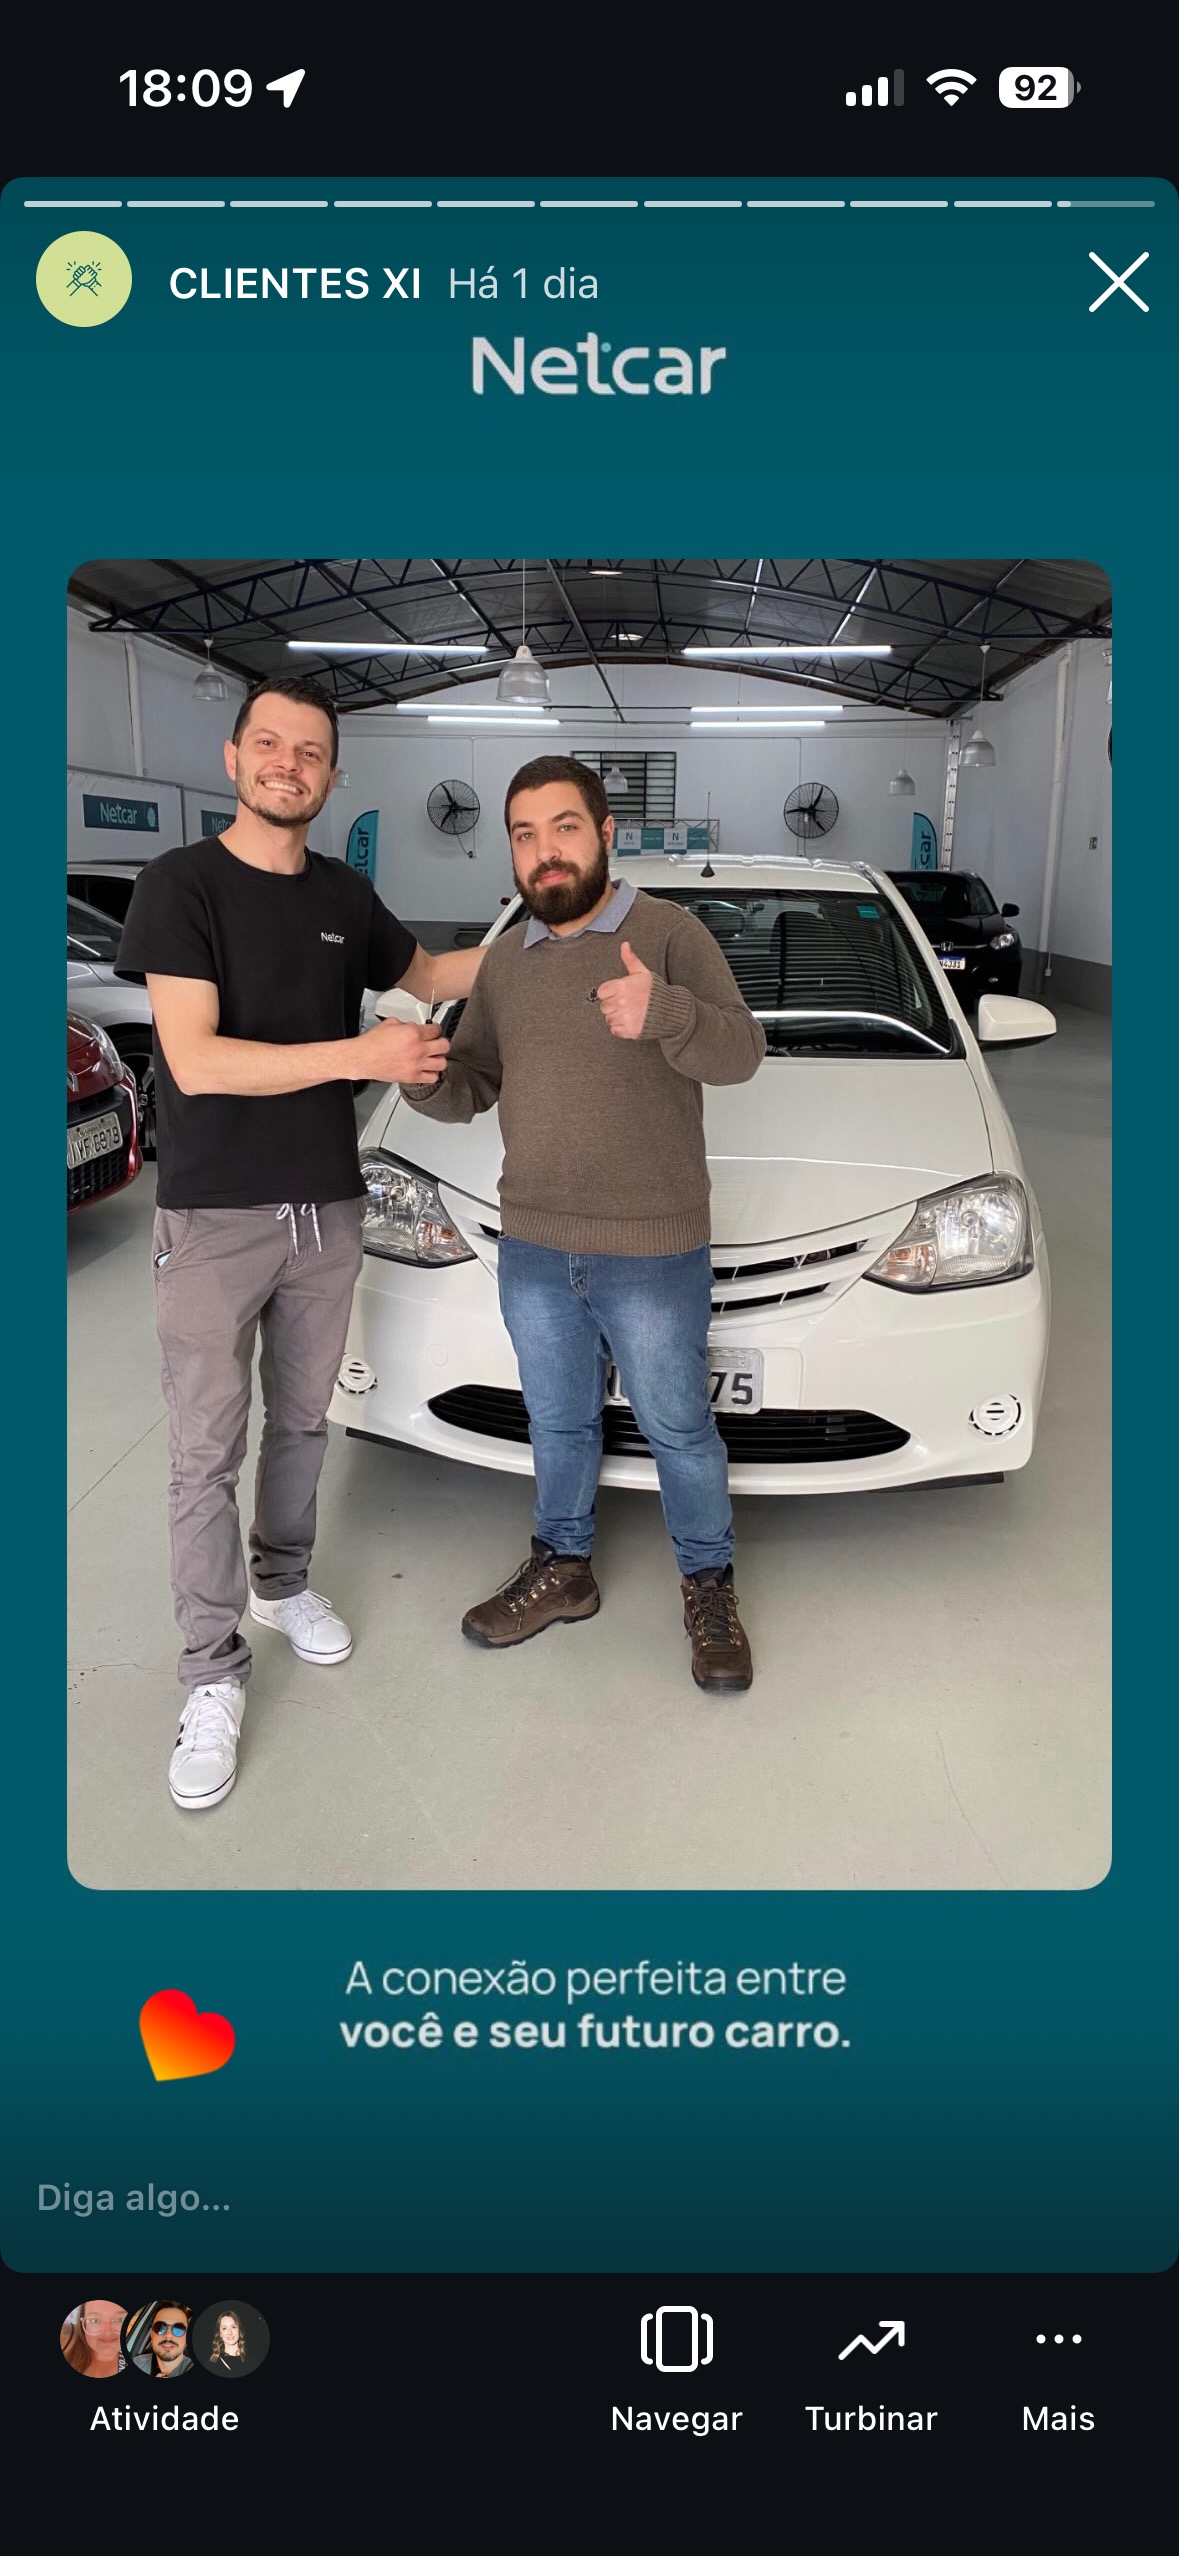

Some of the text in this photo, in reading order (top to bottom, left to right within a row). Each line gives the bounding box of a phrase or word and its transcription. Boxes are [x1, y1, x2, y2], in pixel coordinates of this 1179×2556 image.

[100, 802, 137, 824] Netcar
[920, 831, 931, 869] car
[320, 931, 345, 944] Netcar
